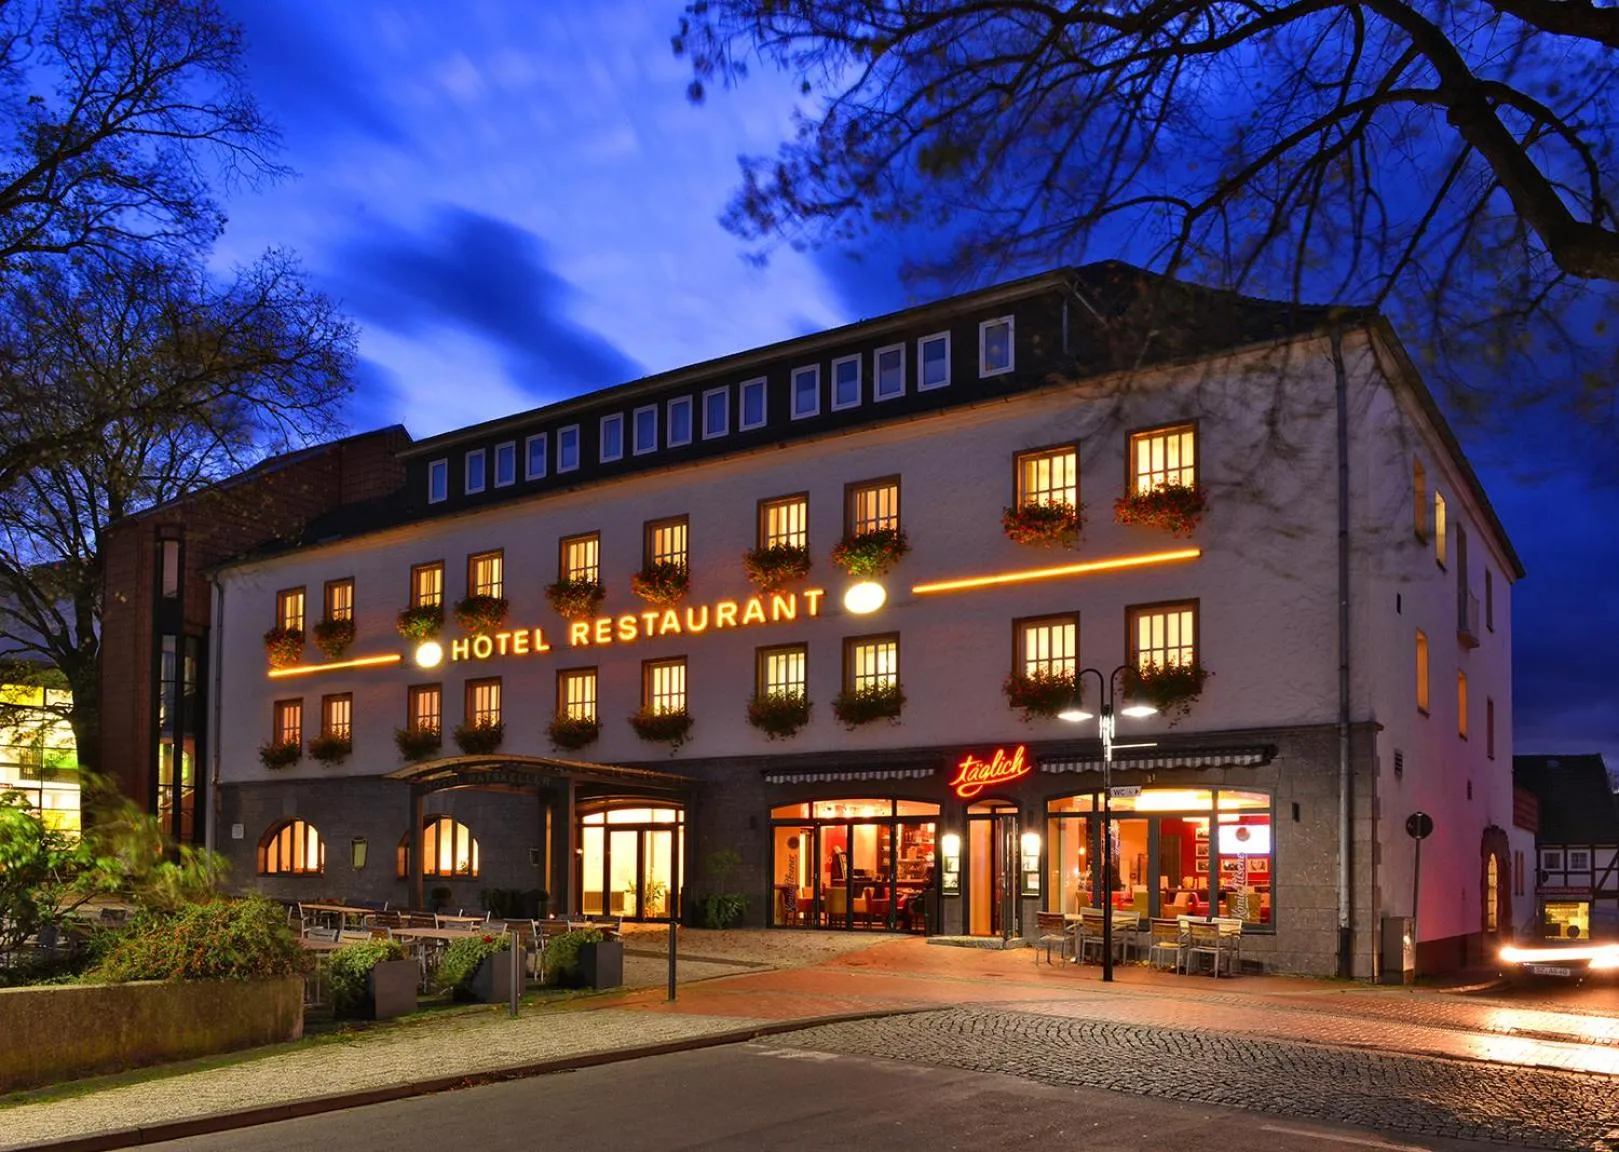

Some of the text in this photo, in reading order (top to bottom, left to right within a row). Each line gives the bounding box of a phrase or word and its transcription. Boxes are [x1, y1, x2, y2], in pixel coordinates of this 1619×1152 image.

[452, 589, 825, 660] HOTEL RESTAURANT
[467, 772, 552, 788] RATSKELLER
[948, 745, 1032, 798] täglich
